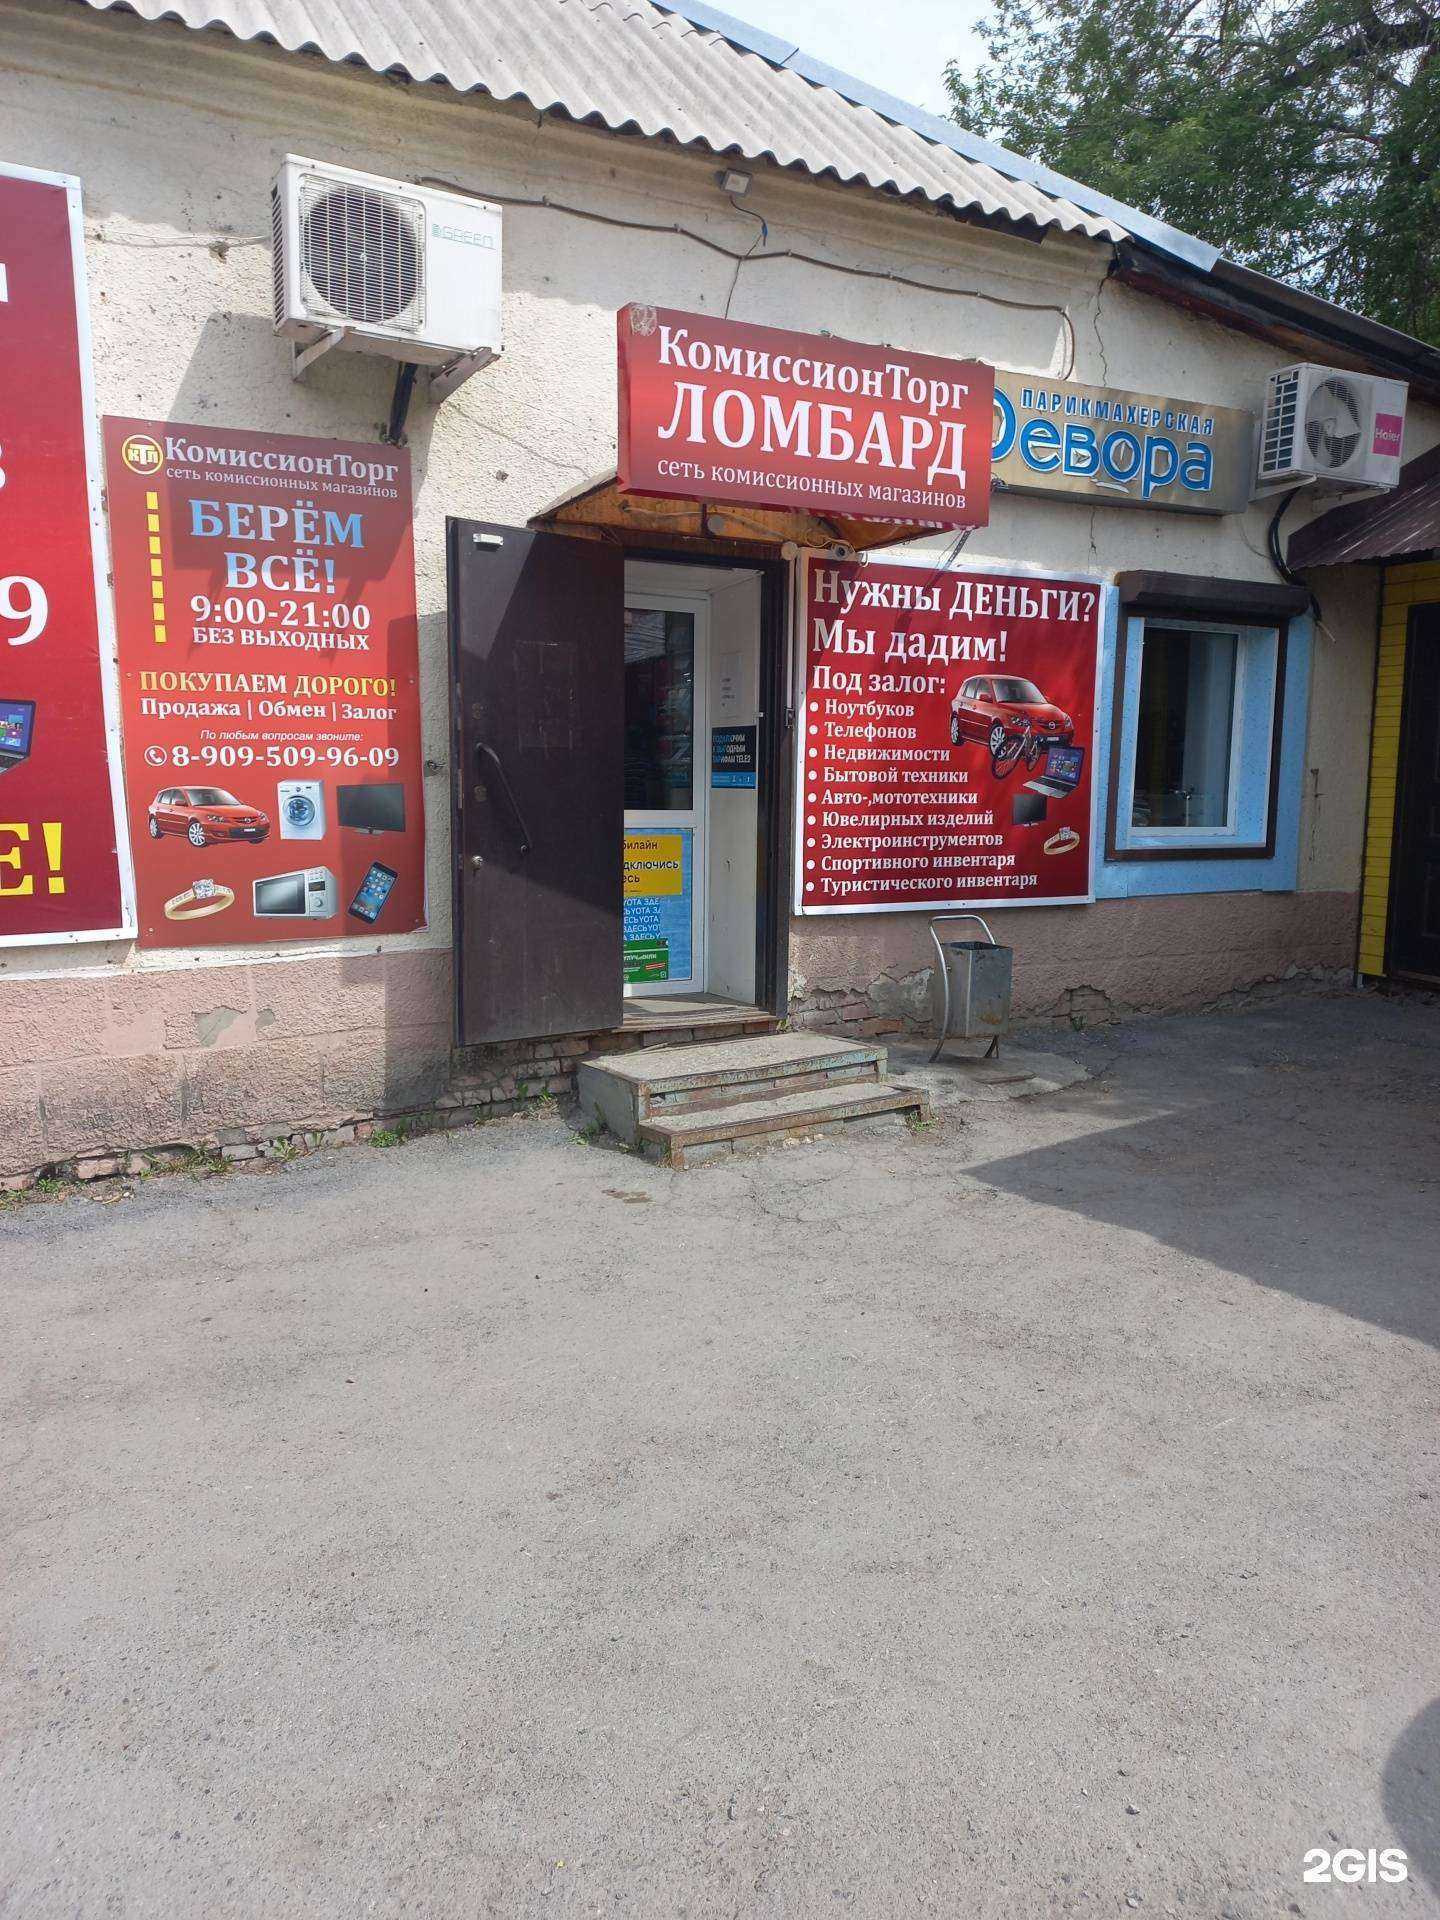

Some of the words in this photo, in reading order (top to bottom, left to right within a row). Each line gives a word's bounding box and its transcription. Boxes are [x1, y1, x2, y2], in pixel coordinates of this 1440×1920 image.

[658, 325, 969, 415] КомиссионТорг
[1020, 387, 1215, 436] ПАРИКМАХЕРСКАЯ
[657, 381, 967, 490] ЛОМБАРД
[164, 436, 398, 486] КомиссионТорг
[166, 467, 200, 480] сеть
[205, 470, 319, 492] комиссионных
[322, 482, 398, 498] магазинов
[657, 459, 705, 479] сеть
[711, 466, 863, 498] комиссионных
[868, 485, 966, 509] магазинов
[188, 499, 365, 548] БЕРЁМ
[224, 548, 336, 594] ВСЁ!
[813, 568, 942, 614] Нужны
[949, 581, 1096, 622] ДЕНЬГИ?
[190, 595, 371, 630] 9:00-21:00
[193, 626, 234, 644] БЕЗ
[240, 628, 370, 651] ВЫХОДНЫХ
[813, 618, 876, 655] Мы
[884, 630, 1008, 666] дадим!
[139, 671, 288, 694] ПОКУПАЕМ
[293, 675, 397, 698] ДОРОГО!
[812, 665, 863, 695] Под
[868, 674, 946, 694] залог:
[140, 698, 241, 719] Продажа
[258, 700, 326, 718] Обмен
[341, 703, 397, 720] Залог
[824, 699, 915, 718] Ноутбуков
[200, 730, 217, 740] По
[219, 731, 259, 741] любым
[262, 733, 313, 742] вопросам
[316, 732, 364, 742] звоните:
[825, 722, 917, 740] Телефонов
[172, 745, 400, 767] 8-909-509-96-09
[823, 744, 950, 762] Недвижимости
[823, 767, 898, 783] Бытовой
[901, 770, 969, 783] техники
[822, 812, 924, 830] Ювелирных
[927, 810, 994, 827] изделий
[821, 833, 1003, 852] Электроинструментов
[821, 856, 929, 875] Спортивного
[932, 853, 1016, 869] инвентаря
[820, 876, 953, 897] Туристического
[956, 872, 1038, 891] инвентаря
